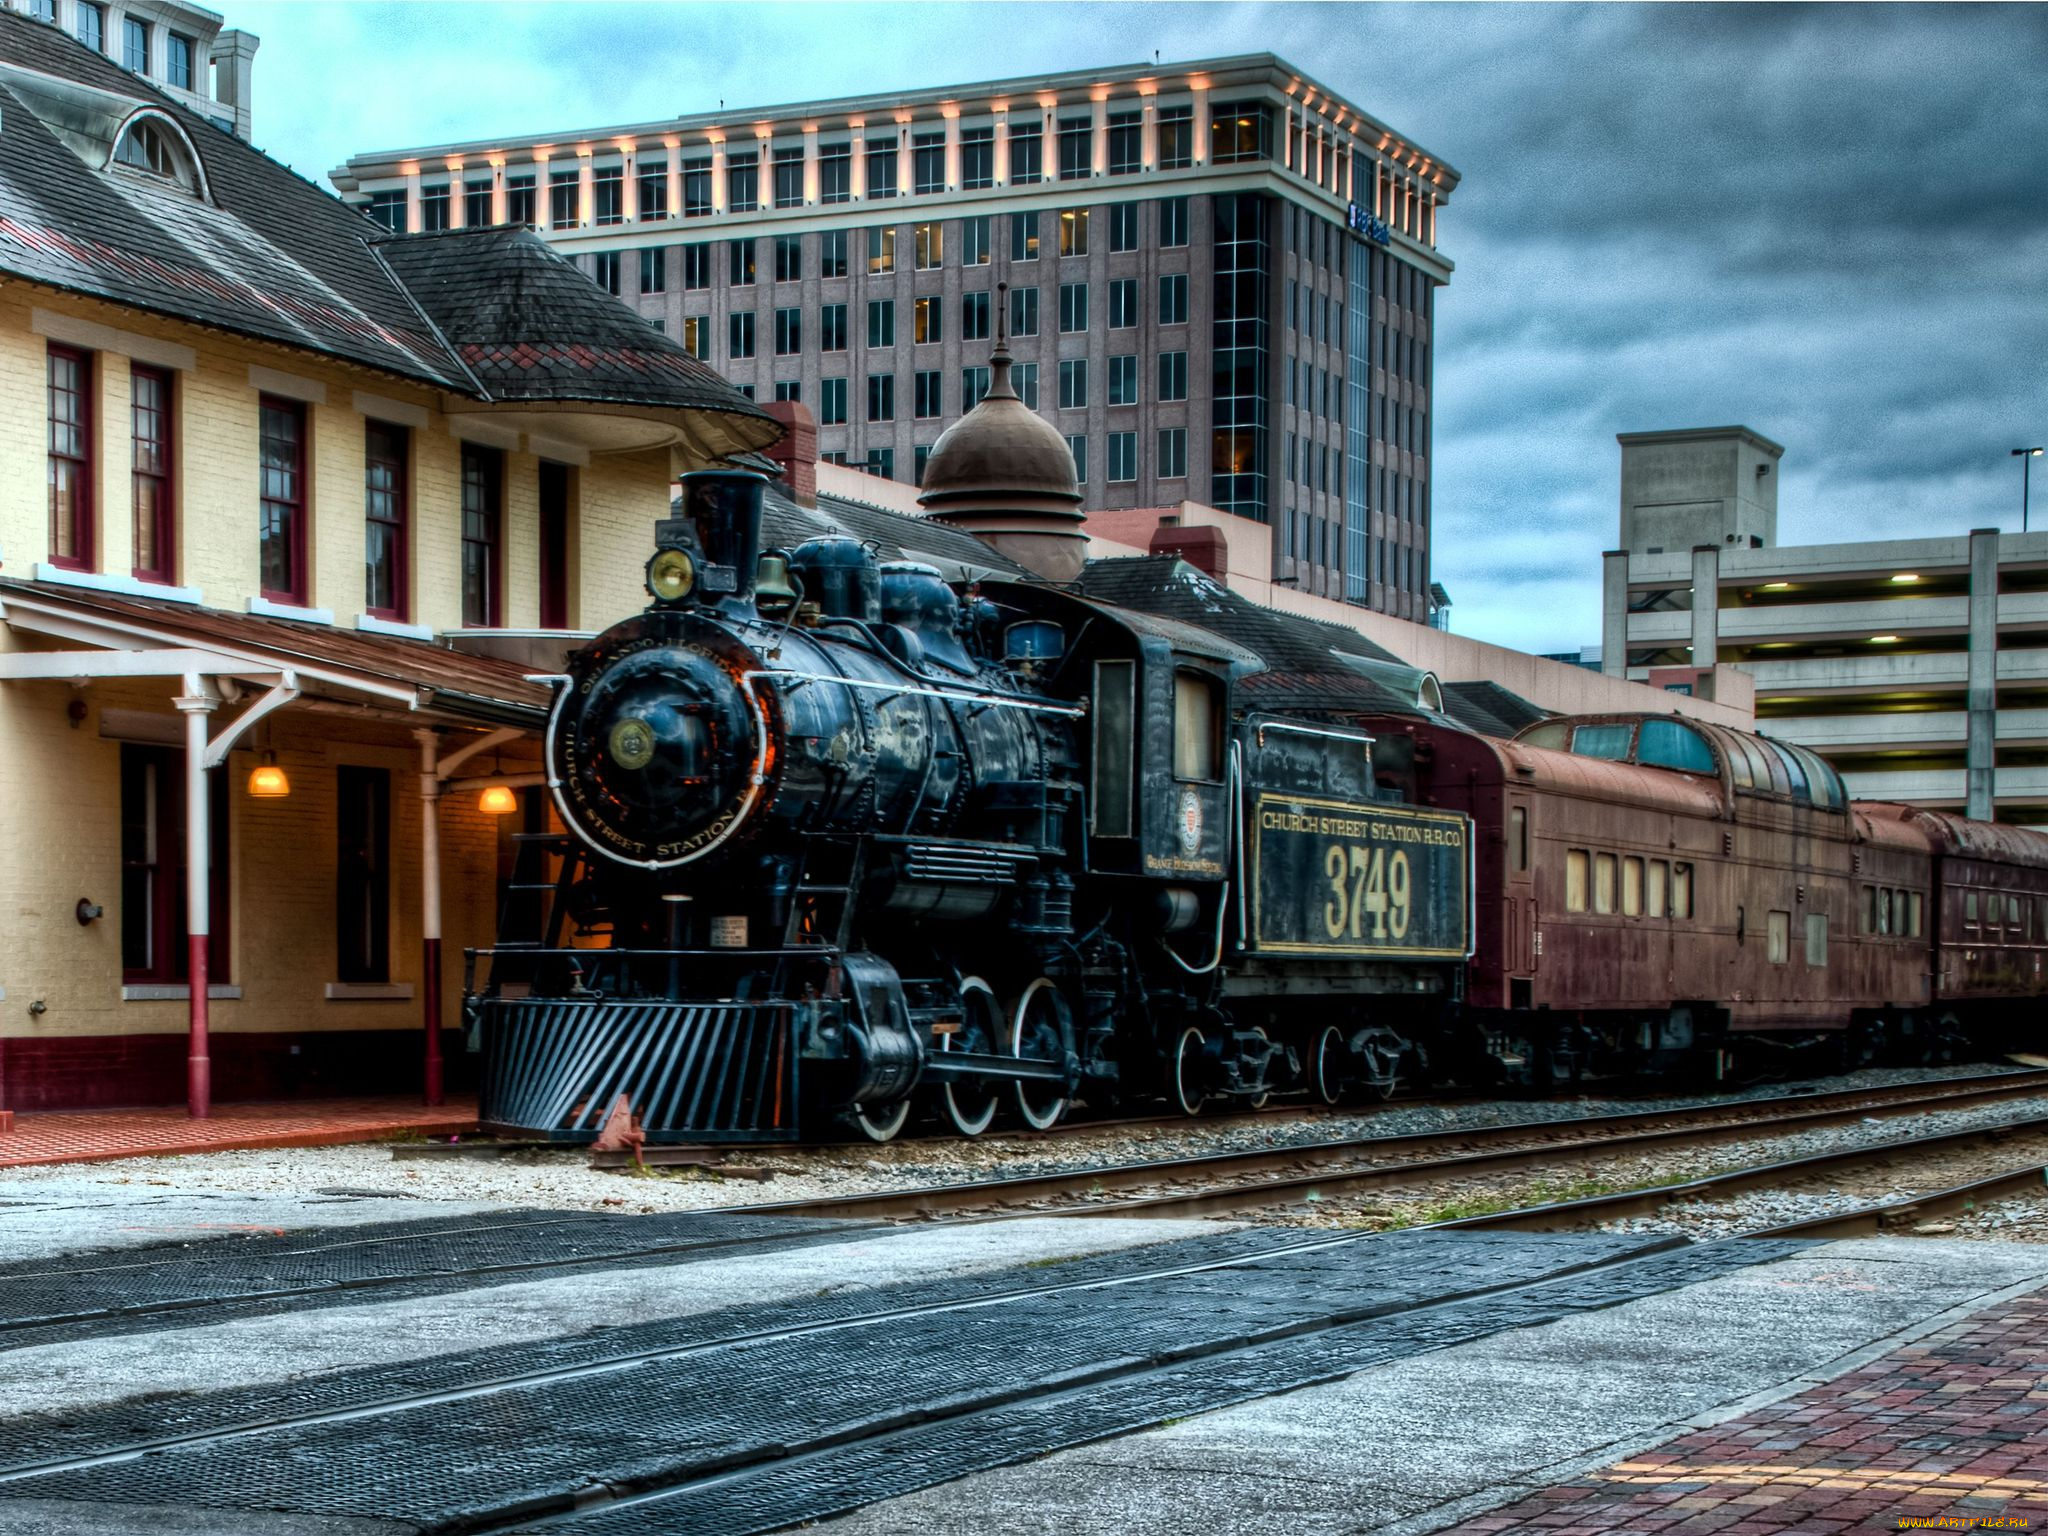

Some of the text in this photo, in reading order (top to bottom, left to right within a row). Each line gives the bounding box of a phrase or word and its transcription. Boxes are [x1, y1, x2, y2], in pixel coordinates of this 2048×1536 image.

[565, 720, 735, 855] CHURCH STREET STATION
[1262, 811, 1319, 833] CHURCH
[1320, 819, 1370, 839] STREET
[1371, 824, 1422, 844] STATION
[1324, 844, 1411, 940] 3749
